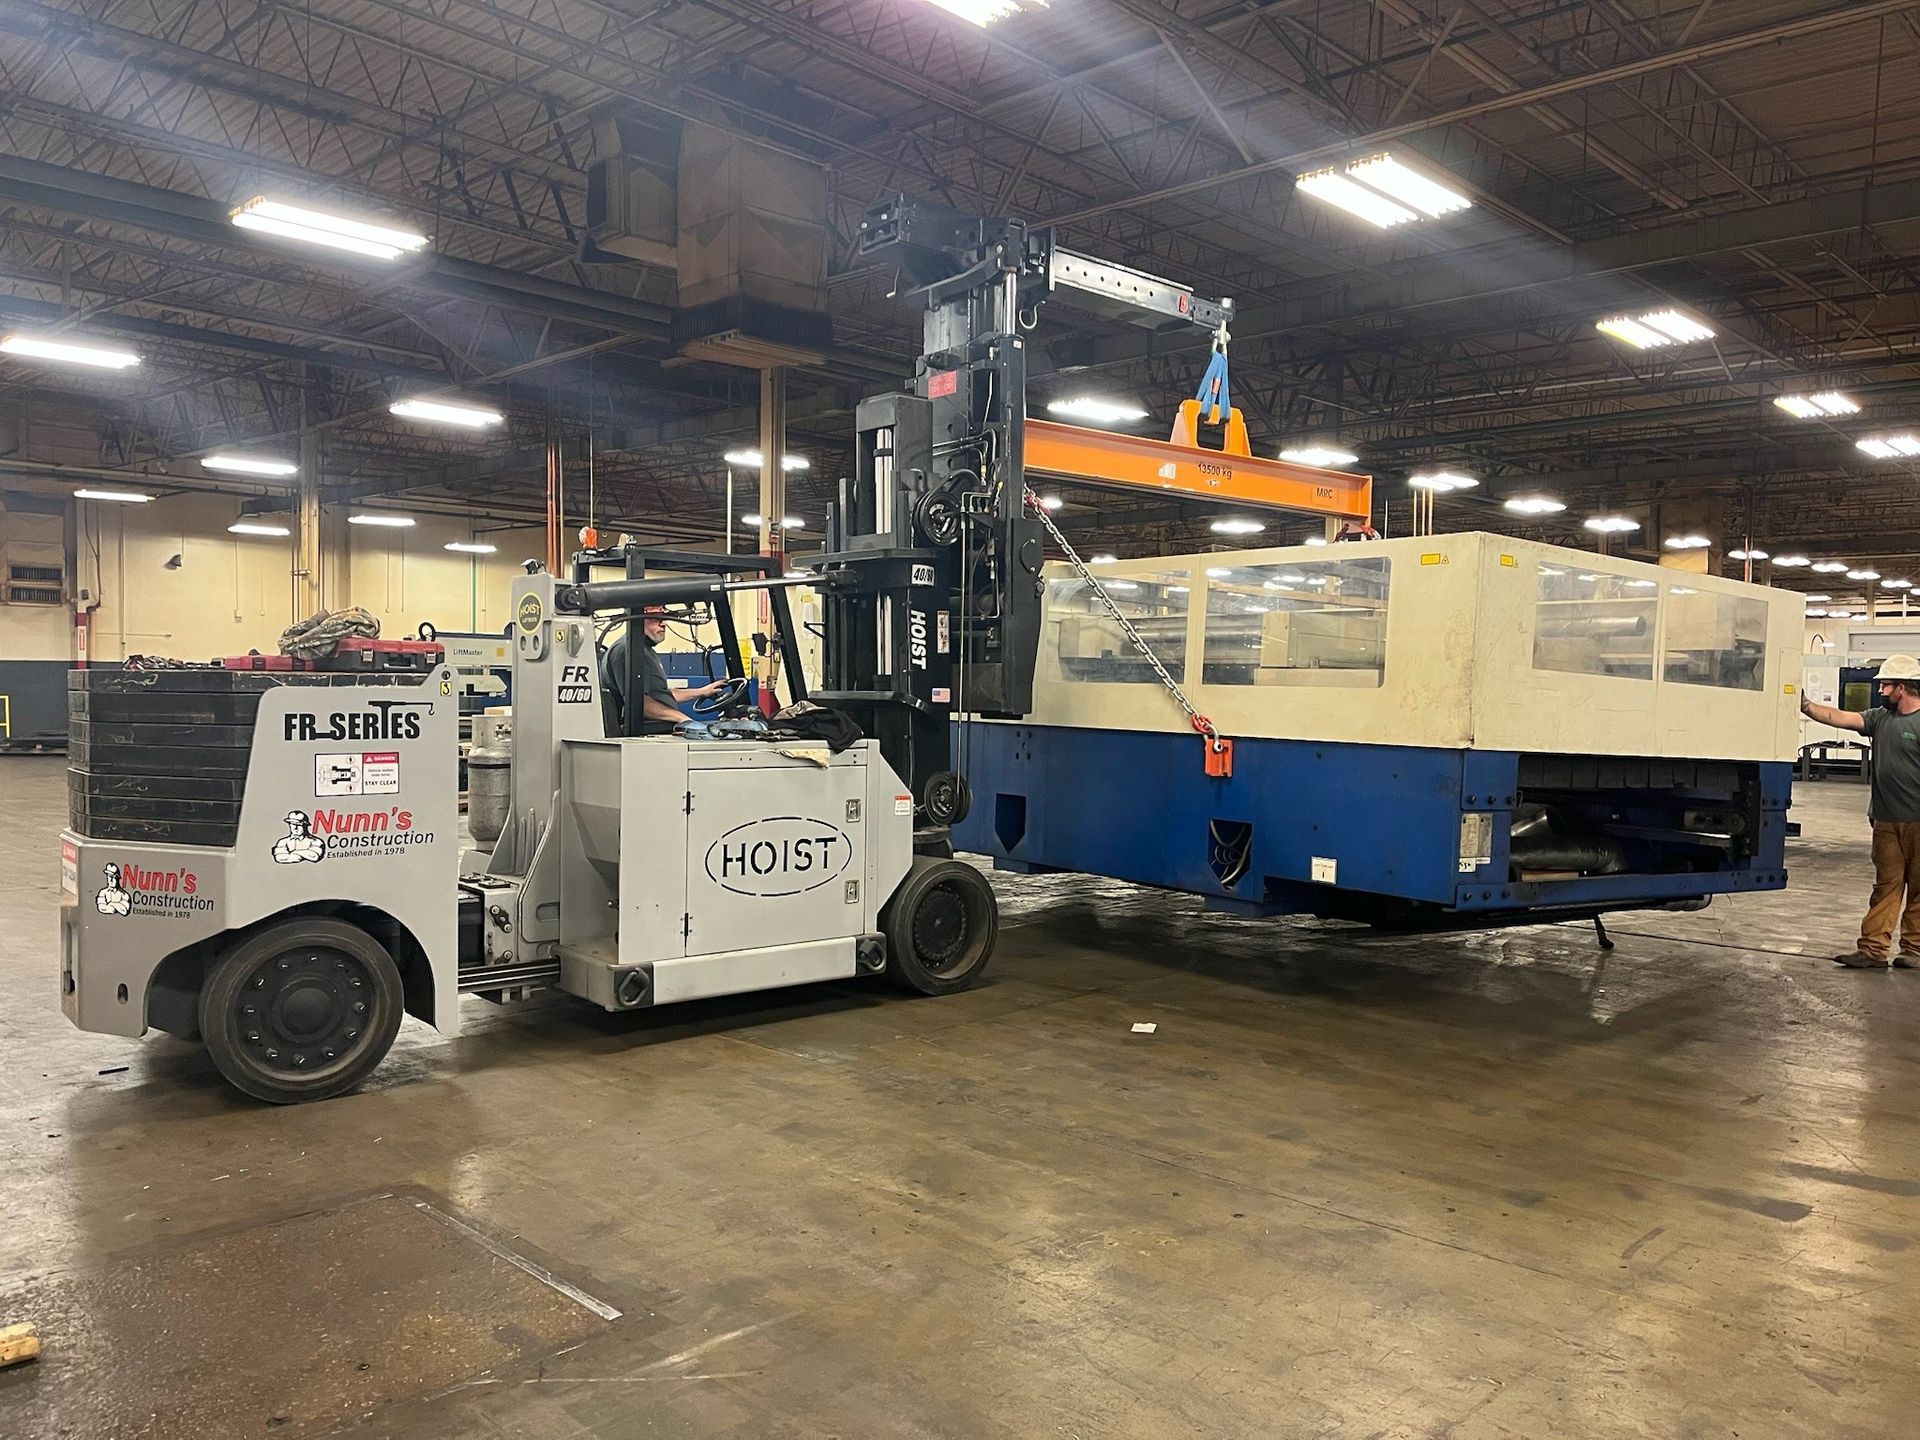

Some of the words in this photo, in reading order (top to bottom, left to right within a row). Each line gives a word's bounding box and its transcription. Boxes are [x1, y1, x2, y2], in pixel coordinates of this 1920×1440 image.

[1198, 463, 1221, 477] 13500
[1222, 468, 1232, 480] kg
[1316, 487, 1333, 499] MRC
[520, 603, 540, 618] HOIST
[910, 609, 927, 670] HOIST
[453, 648, 483, 656] LiftMaster
[561, 665, 590, 683] FR
[559, 688, 592, 702] 40/60
[311, 806, 413, 835] Nunn's
[326, 830, 434, 849] Construction
[326, 849, 373, 859] Established
[374, 848, 382, 856] in
[384, 847, 405, 856] 1978
[722, 836, 837, 878] HOIST
[121, 863, 197, 894] Nunn's
[132, 890, 214, 911] Construction
[132, 907, 167, 918] Established
[167, 909, 174, 918] in
[174, 911, 191, 920] 1978
